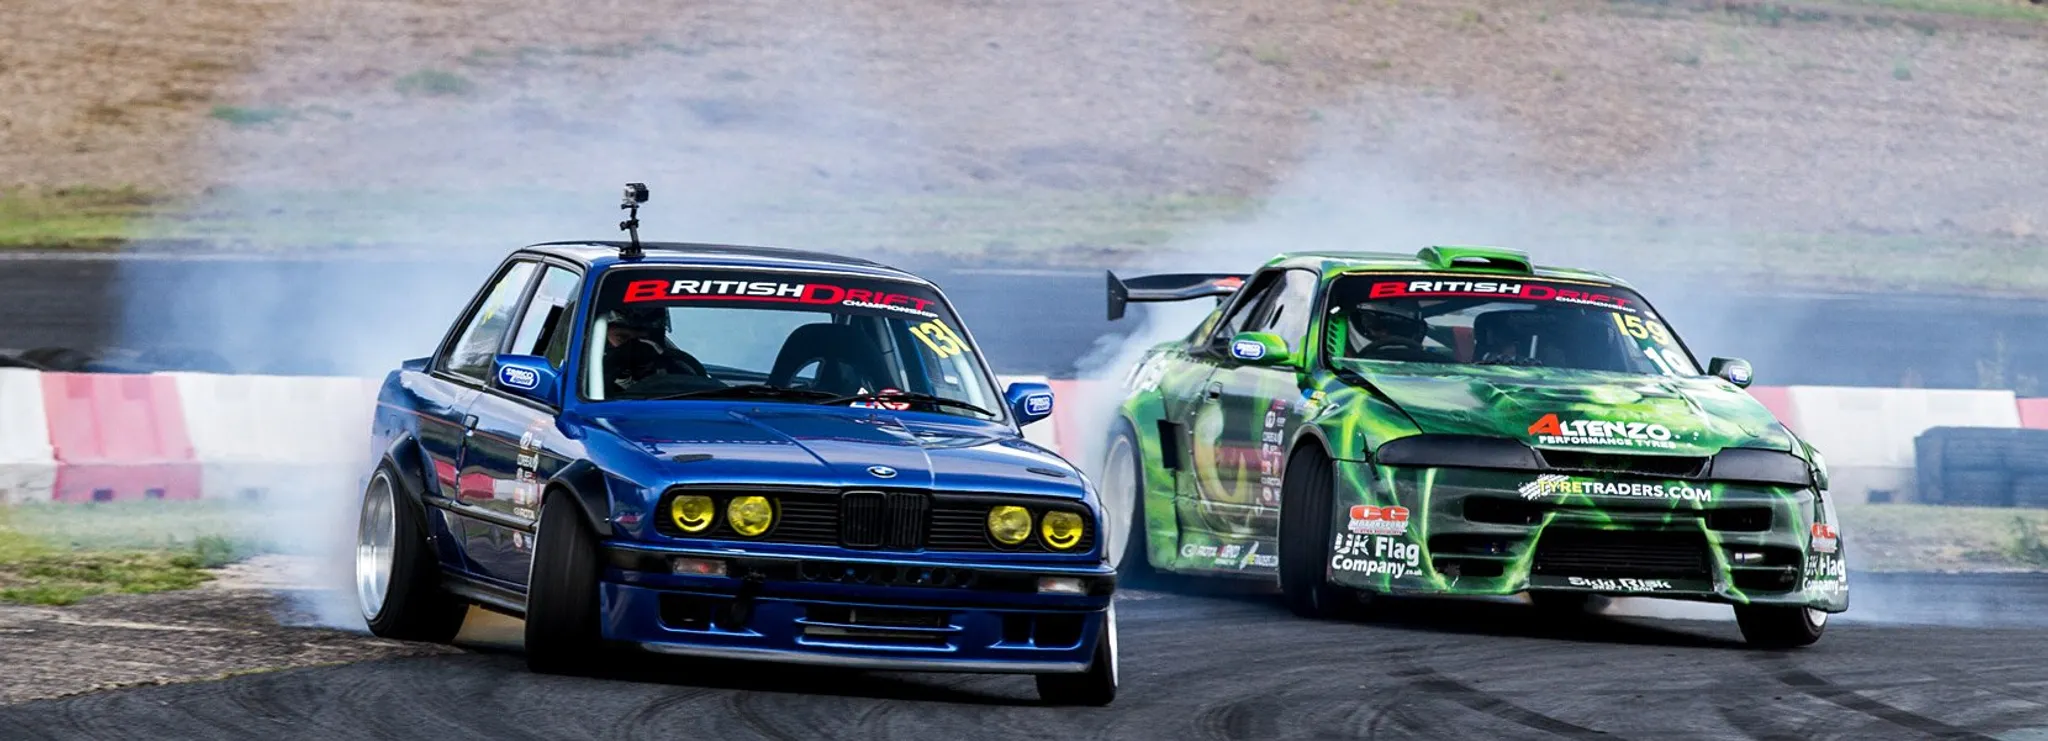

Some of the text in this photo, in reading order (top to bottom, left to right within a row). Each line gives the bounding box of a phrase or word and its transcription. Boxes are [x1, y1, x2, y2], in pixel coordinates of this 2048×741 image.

[842, 299, 940, 319] CHAMPIONSHIP
[1555, 296, 1637, 313] CHAMPIONSHIP
[908, 318, 971, 359] 131
[1612, 312, 1669, 346] 159
[1527, 413, 1672, 441] ALTENZO
[1539, 435, 1677, 449] PERFORMANCE TYRES
[1539, 480, 1712, 502] TYRETRADERS.COM
[1334, 533, 1420, 567] UK Flag
